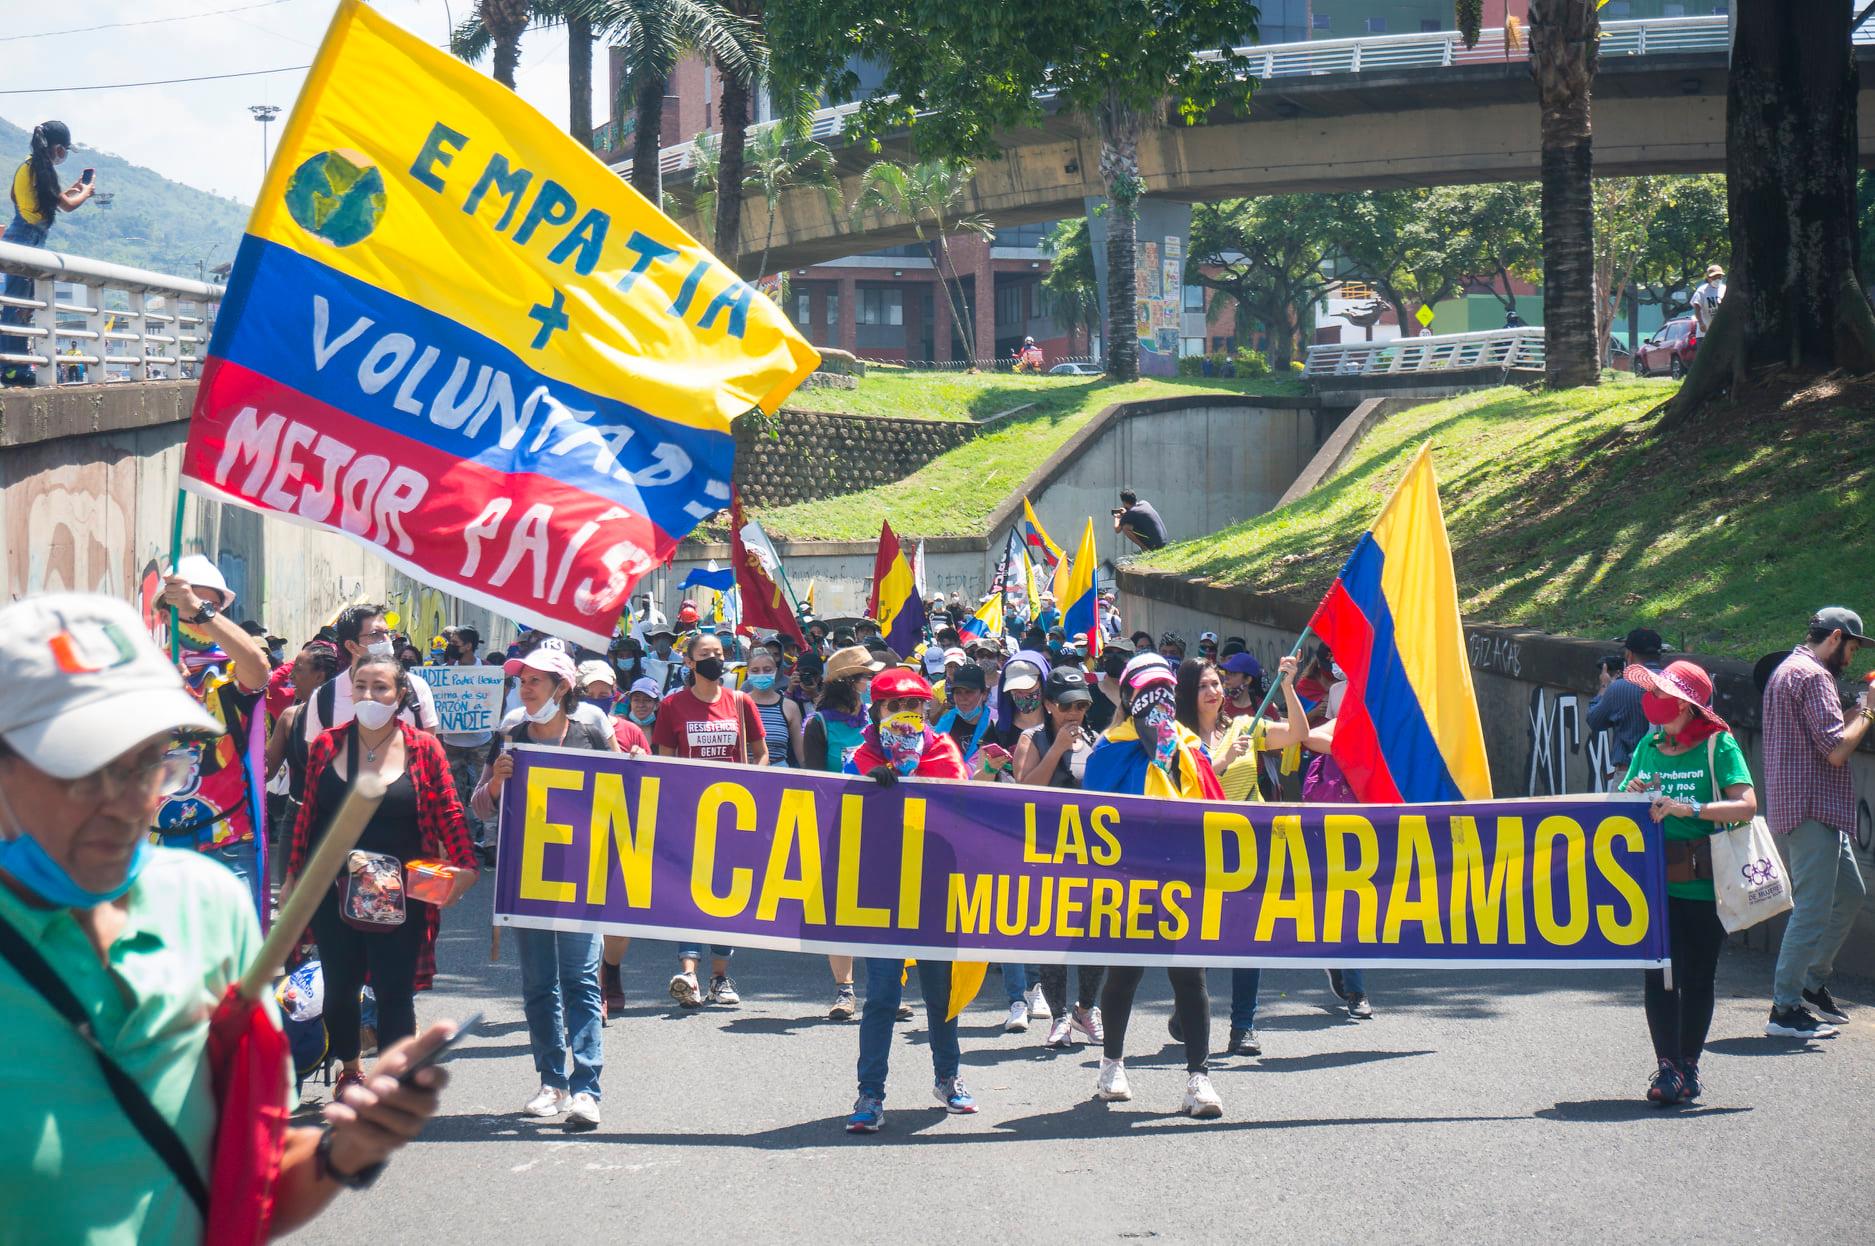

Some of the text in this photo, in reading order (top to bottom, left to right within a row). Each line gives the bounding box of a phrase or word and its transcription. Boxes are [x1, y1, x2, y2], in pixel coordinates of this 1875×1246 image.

[409, 121, 755, 338] EMPATIA
[313, 296, 693, 487] VOLUNTAD
[215, 407, 429, 555] MEJOR
[441, 711, 492, 730] NADIE
[697, 734, 732, 743] AGUANTE
[701, 747, 727, 757] GENTE
[1676, 783, 1696, 791] nos
[520, 766, 927, 930] EN CALI
[1022, 802, 1122, 867] LAS
[946, 872, 1192, 941] MUJERES
[1200, 811, 1650, 946] PARAMOS
